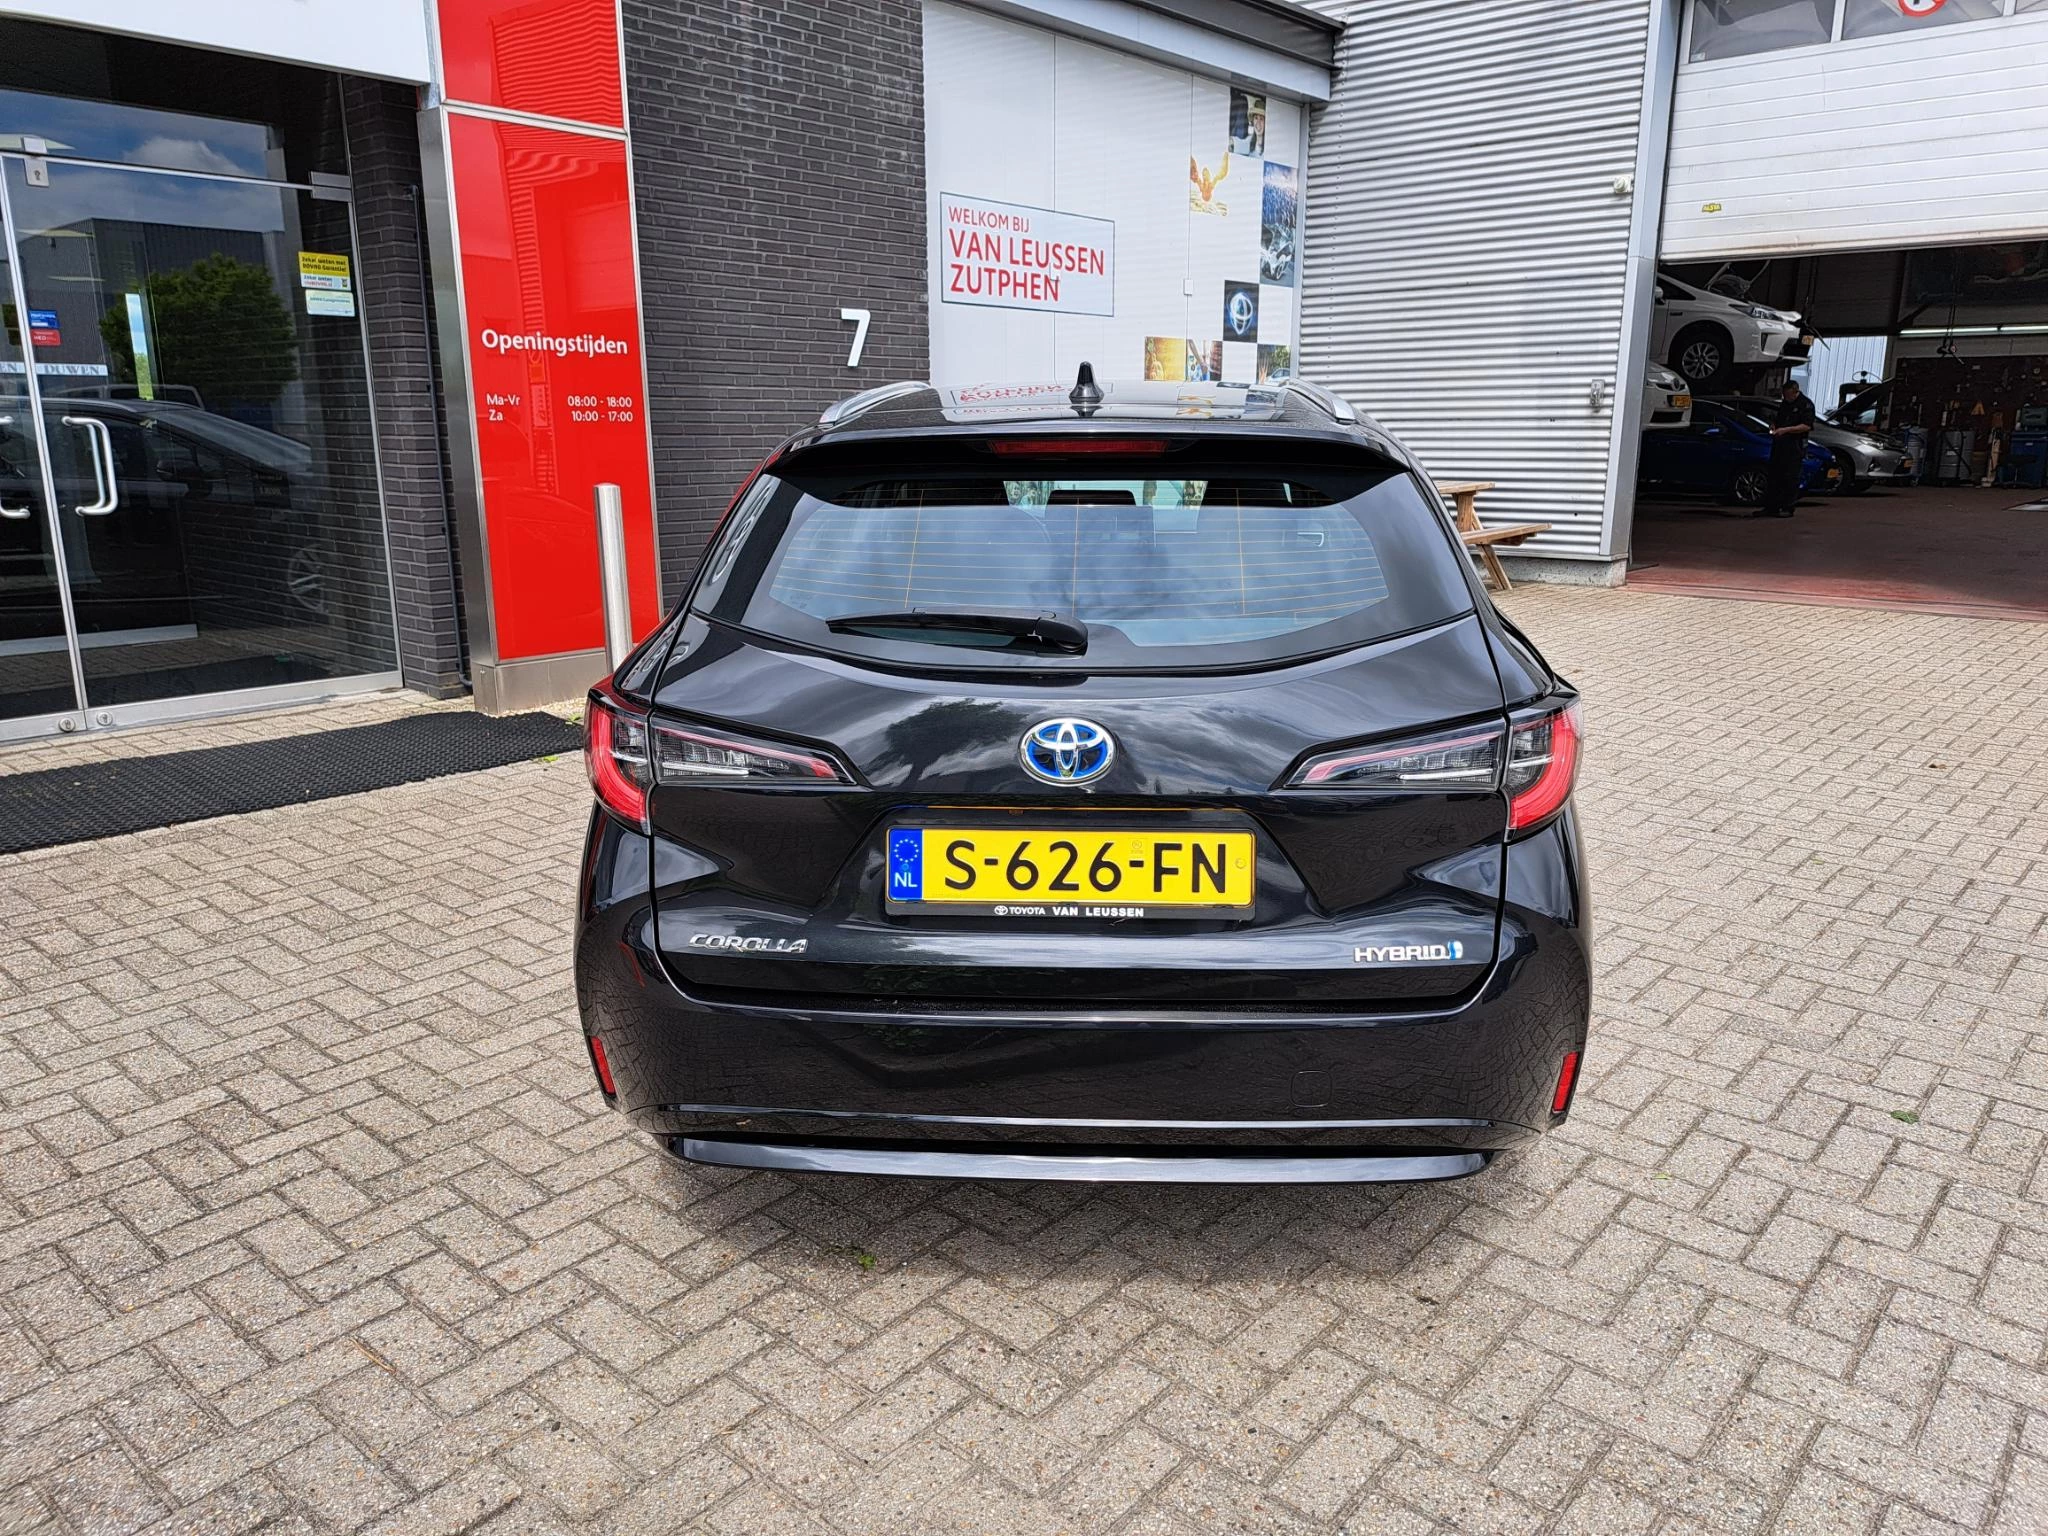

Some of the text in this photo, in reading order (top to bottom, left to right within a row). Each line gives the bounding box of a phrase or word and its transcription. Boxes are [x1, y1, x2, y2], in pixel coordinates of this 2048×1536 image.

[948, 205, 1030, 233] WELKOM BIJ
[948, 227, 1105, 276] VAN LEUSSEN
[950, 264, 1060, 302] ZUTPHEN
[481, 328, 628, 358] Openingstijden
[841, 308, 871, 367] 7
[43, 364, 101, 375] DUWEN
[486, 393, 520, 406] Ma-Vr
[567, 395, 597, 407] 08:00
[607, 396, 633, 408] 18:00
[488, 409, 504, 421] Za
[571, 411, 599, 422] 10:00
[608, 411, 634, 422] 17:00
[944, 839, 1227, 894] S-626-FN
[894, 872, 918, 888] NL
[1009, 906, 1144, 918] TOYOTA VAN LEUSSEN
[688, 933, 808, 954] COROLLA
[1354, 944, 1448, 962] HYBRID
